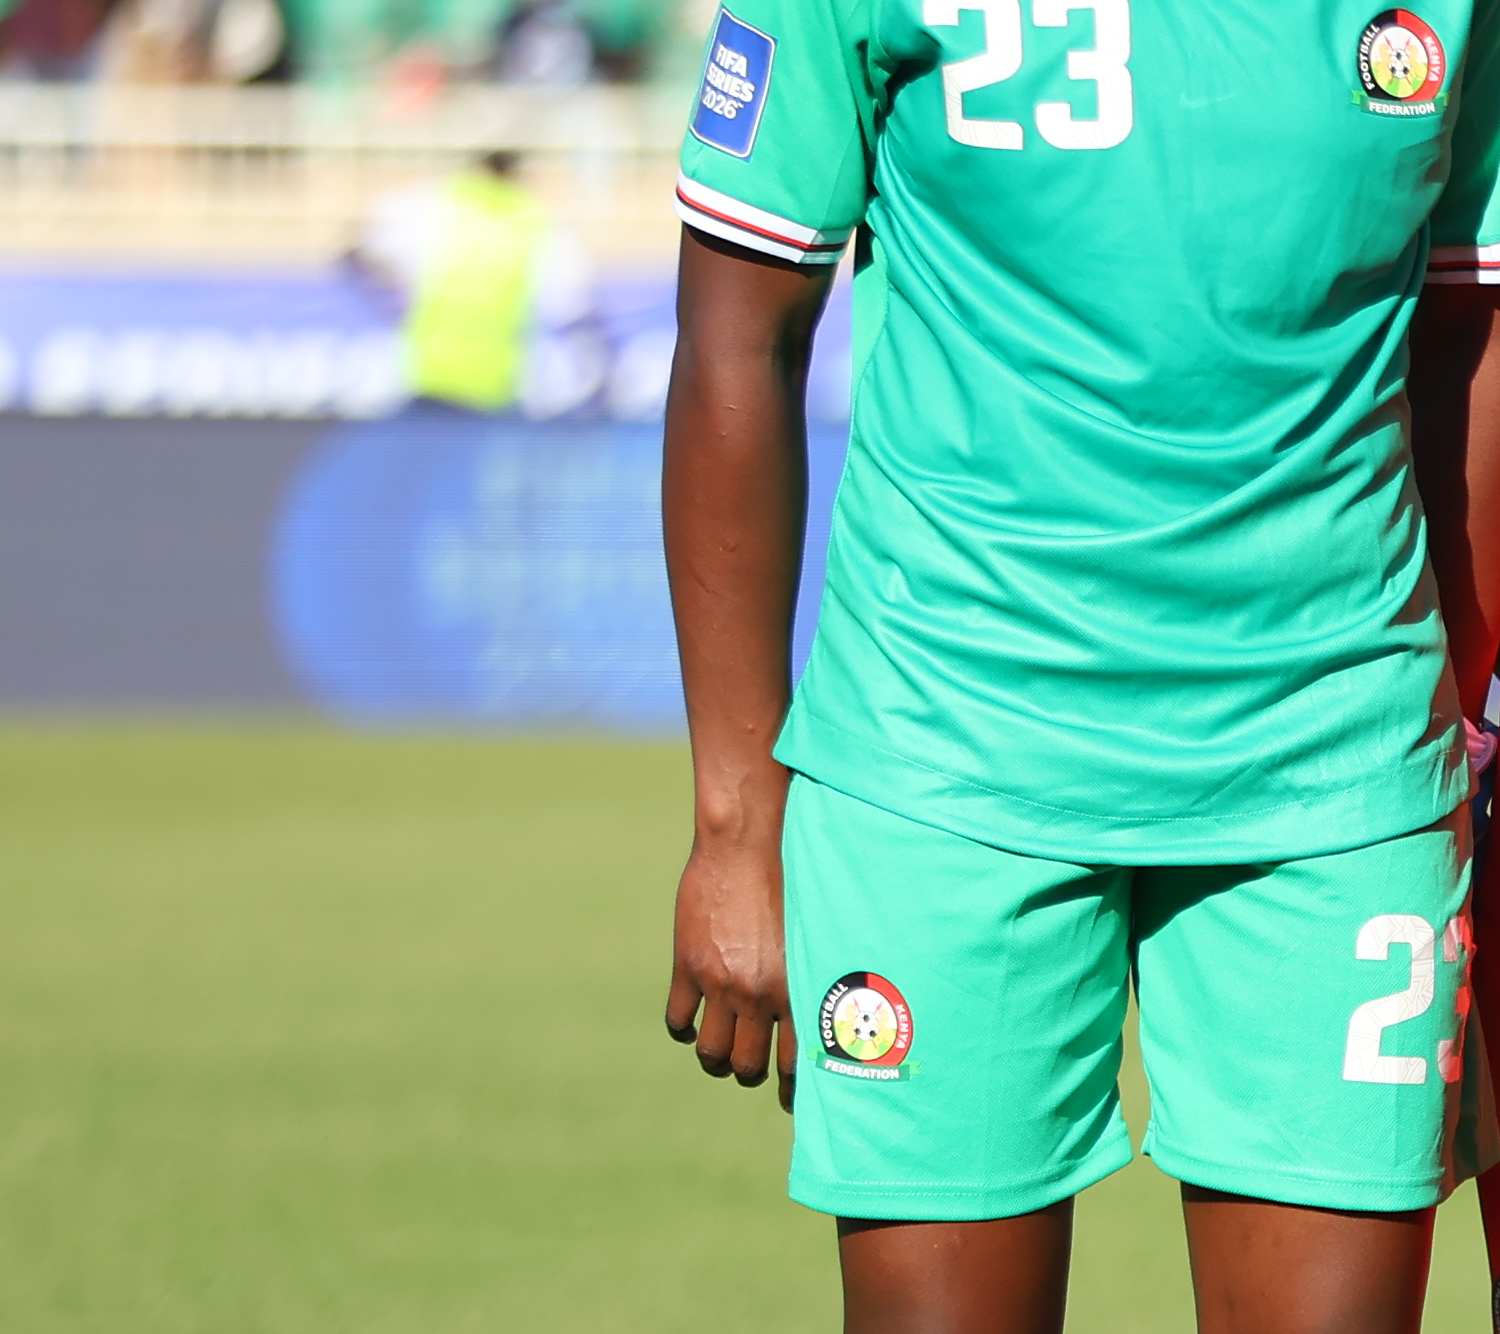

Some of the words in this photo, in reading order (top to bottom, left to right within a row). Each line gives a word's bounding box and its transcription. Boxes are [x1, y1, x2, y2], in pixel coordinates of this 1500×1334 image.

[715, 43, 748, 78] FIFA
[1358, 23, 1382, 91] FOOTBALL
[1423, 35, 1441, 83] KENYA
[705, 62, 756, 103] SERIES
[1368, 101, 1436, 116] FEDERATION
[821, 982, 849, 1049] FOOTBALL
[895, 1003, 909, 1049] KENYA
[824, 1059, 900, 1080] FEDERATION
